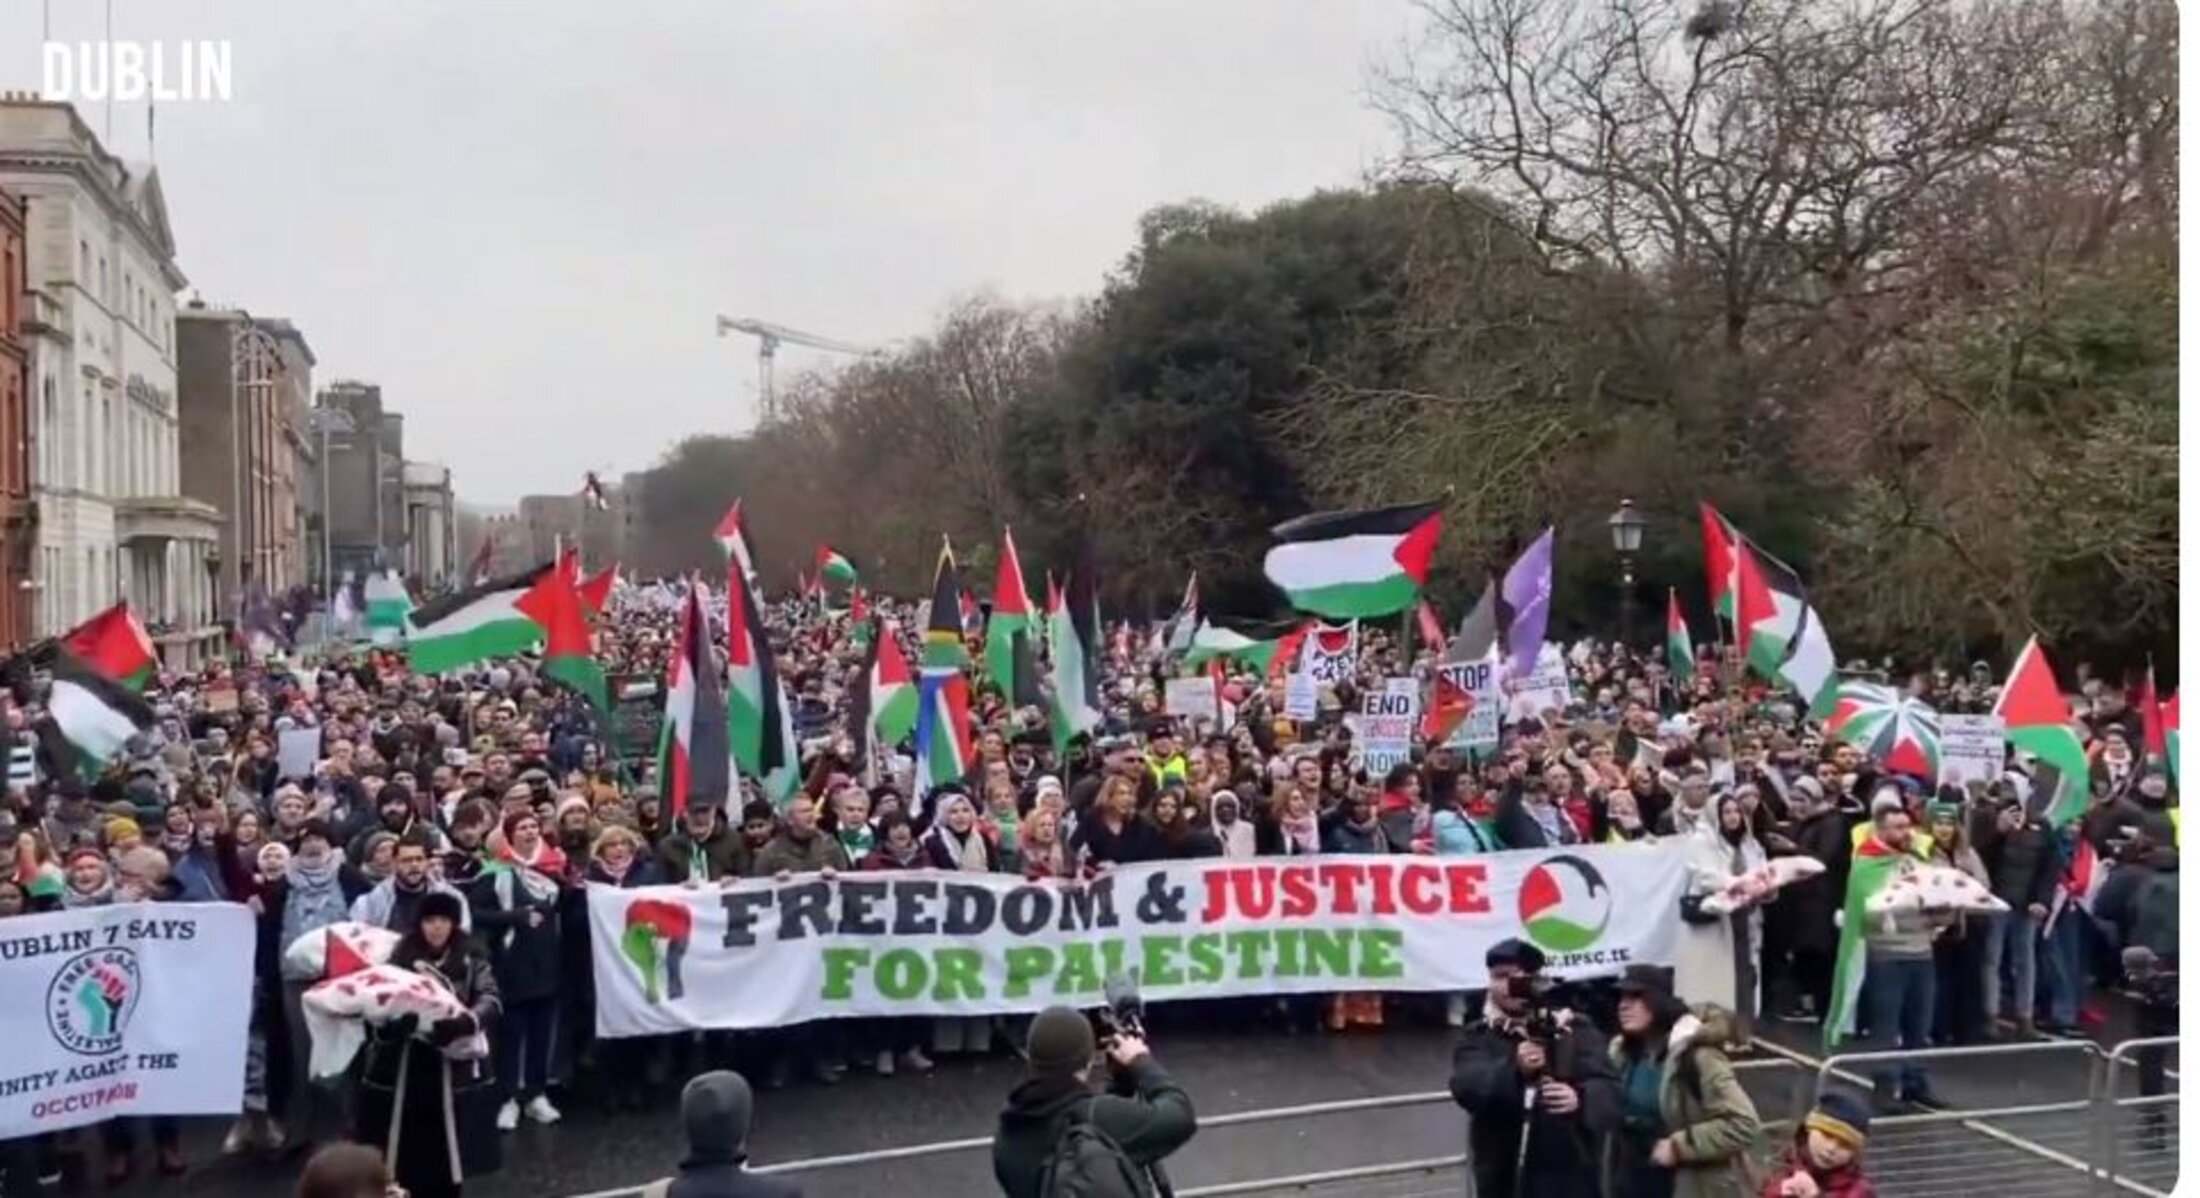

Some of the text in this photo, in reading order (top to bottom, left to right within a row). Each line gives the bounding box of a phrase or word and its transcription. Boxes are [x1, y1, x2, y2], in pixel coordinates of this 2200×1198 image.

[1440, 664, 1489, 690] STOP
[1366, 695, 1409, 715] END
[721, 864, 1490, 948] FREEDOM & JUSTICE
[0, 919, 196, 959] UBLIN 7 SAYS
[821, 929, 1403, 1001] FOR PALESTINE
[0, 1069, 58, 1097] NITY
[137, 1053, 178, 1070] THE
